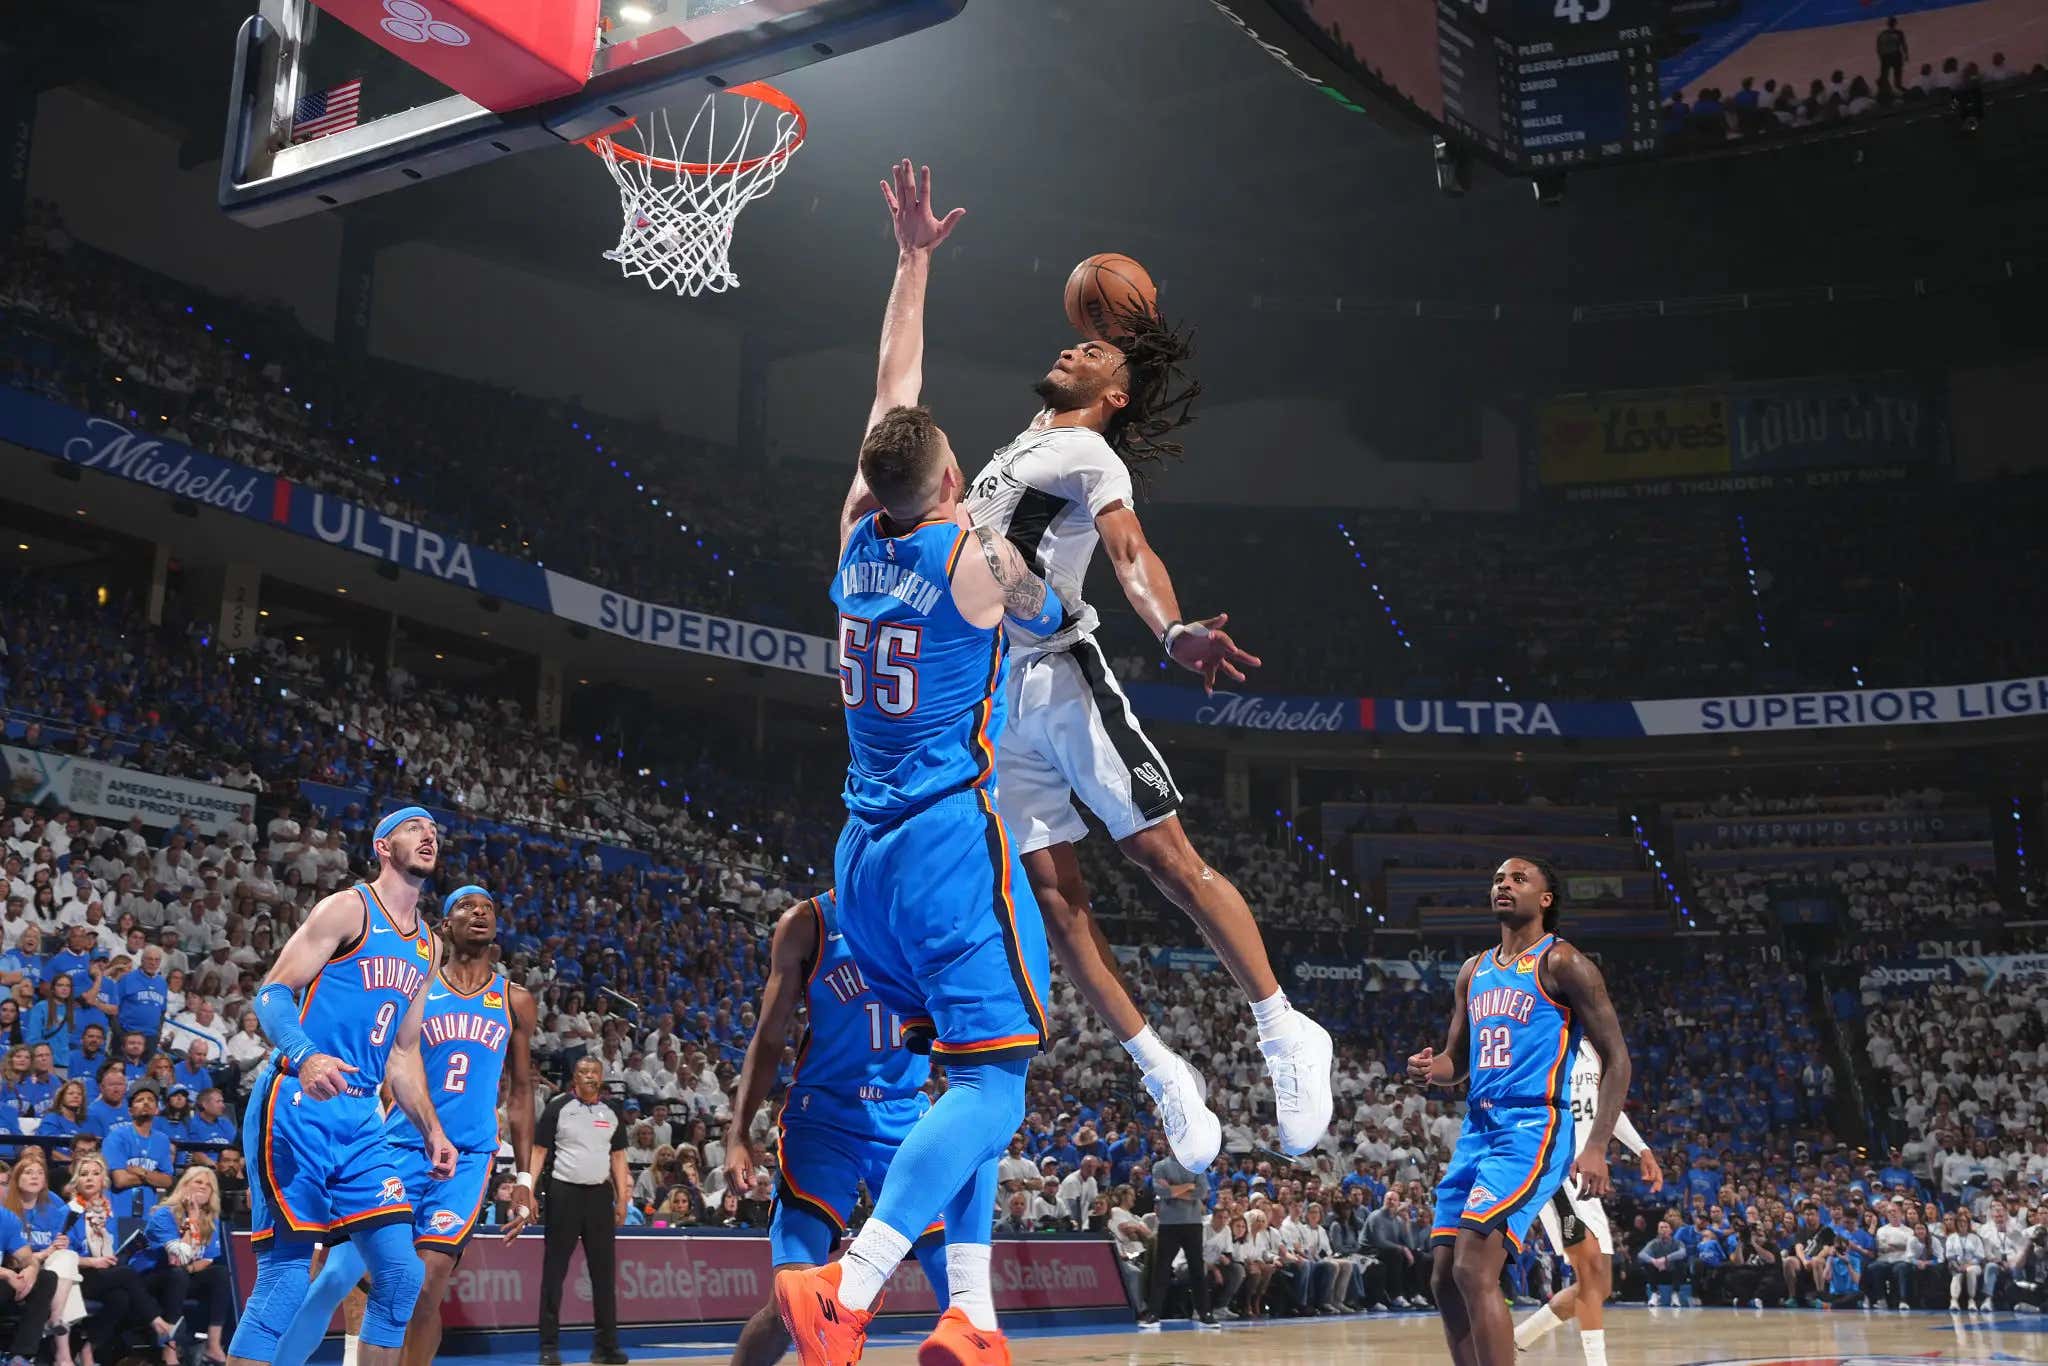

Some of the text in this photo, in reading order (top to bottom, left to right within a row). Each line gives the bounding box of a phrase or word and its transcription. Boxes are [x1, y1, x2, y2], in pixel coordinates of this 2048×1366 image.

[1518, 42, 1553, 56] PLAYER
[63, 418, 478, 587] Michelob ULTRA
[600, 593, 806, 669] SUPERIOR
[839, 612, 924, 719] 55
[1195, 690, 1562, 736] Michelob ULTRA
[1701, 690, 1937, 730] SUPERIOR
[106, 794, 135, 809] GAS
[188, 794, 240, 813] LARGES
[1717, 817, 1946, 839] RIVERWIND CASINO
[358, 956, 425, 1001] THUNDE
[370, 1000, 398, 1047] 9
[1469, 987, 1537, 1027] THUNDER
[420, 1011, 507, 1053] THUNDER
[1478, 1024, 1512, 1070] 22
[443, 1049, 471, 1094] 2
[1571, 1098, 1595, 1122] 24
